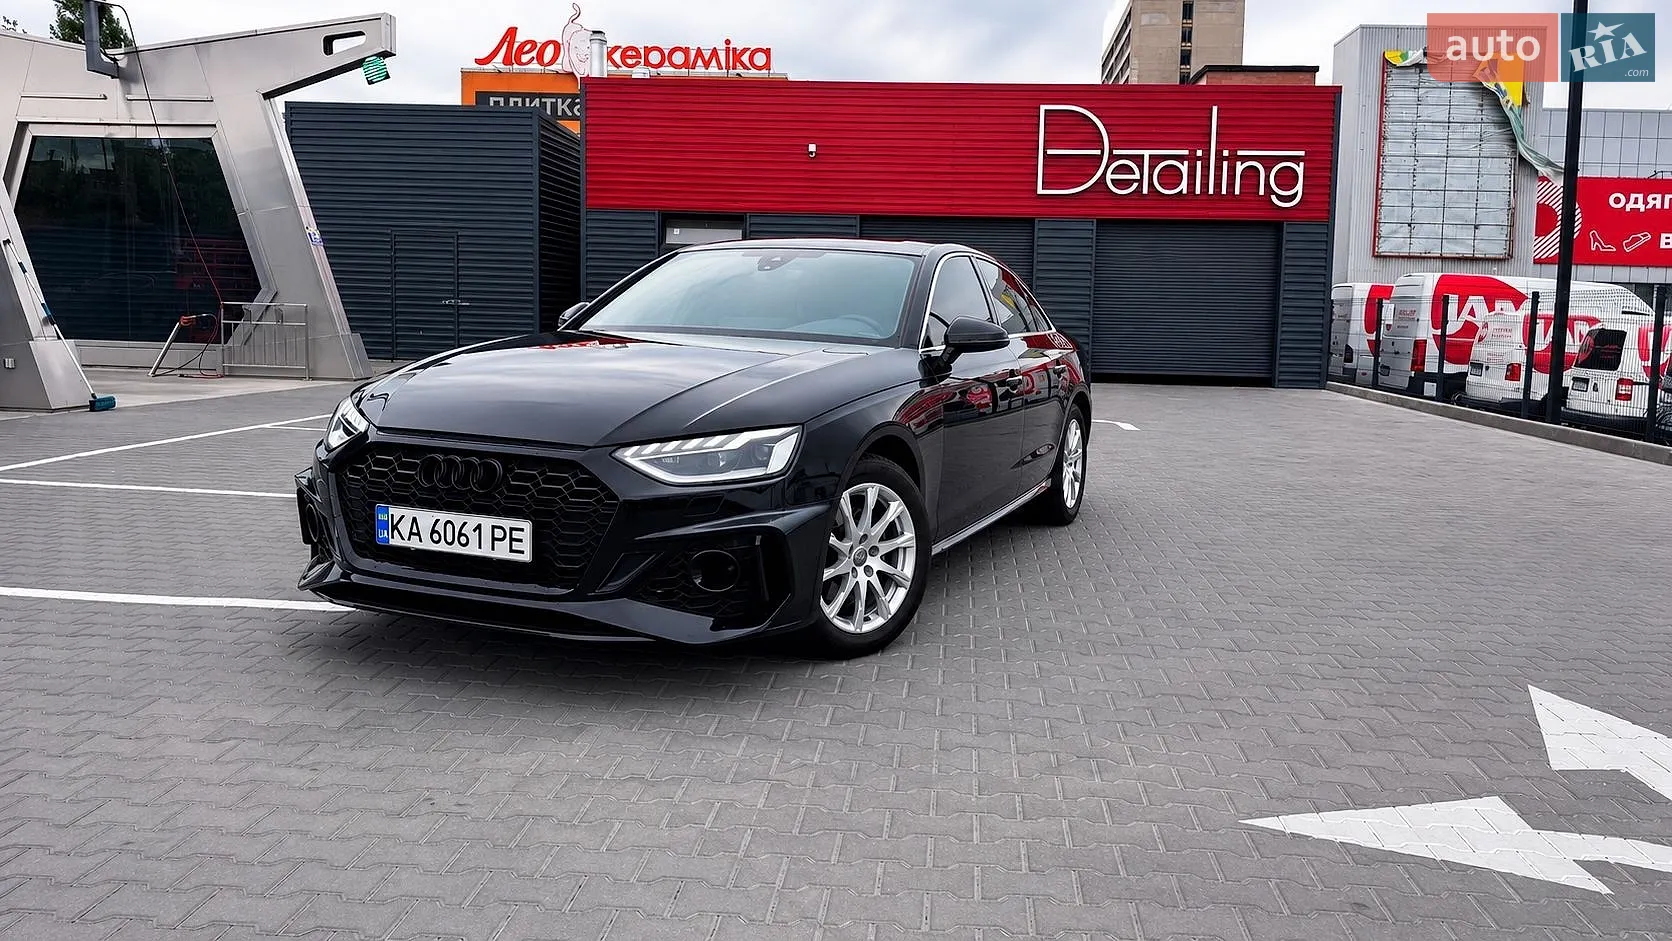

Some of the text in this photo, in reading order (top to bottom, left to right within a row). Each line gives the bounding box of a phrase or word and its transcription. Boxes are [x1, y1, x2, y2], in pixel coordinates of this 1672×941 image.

[475, 26, 561, 66] Лео
[390, 513, 526, 555] KA 6061 PE
